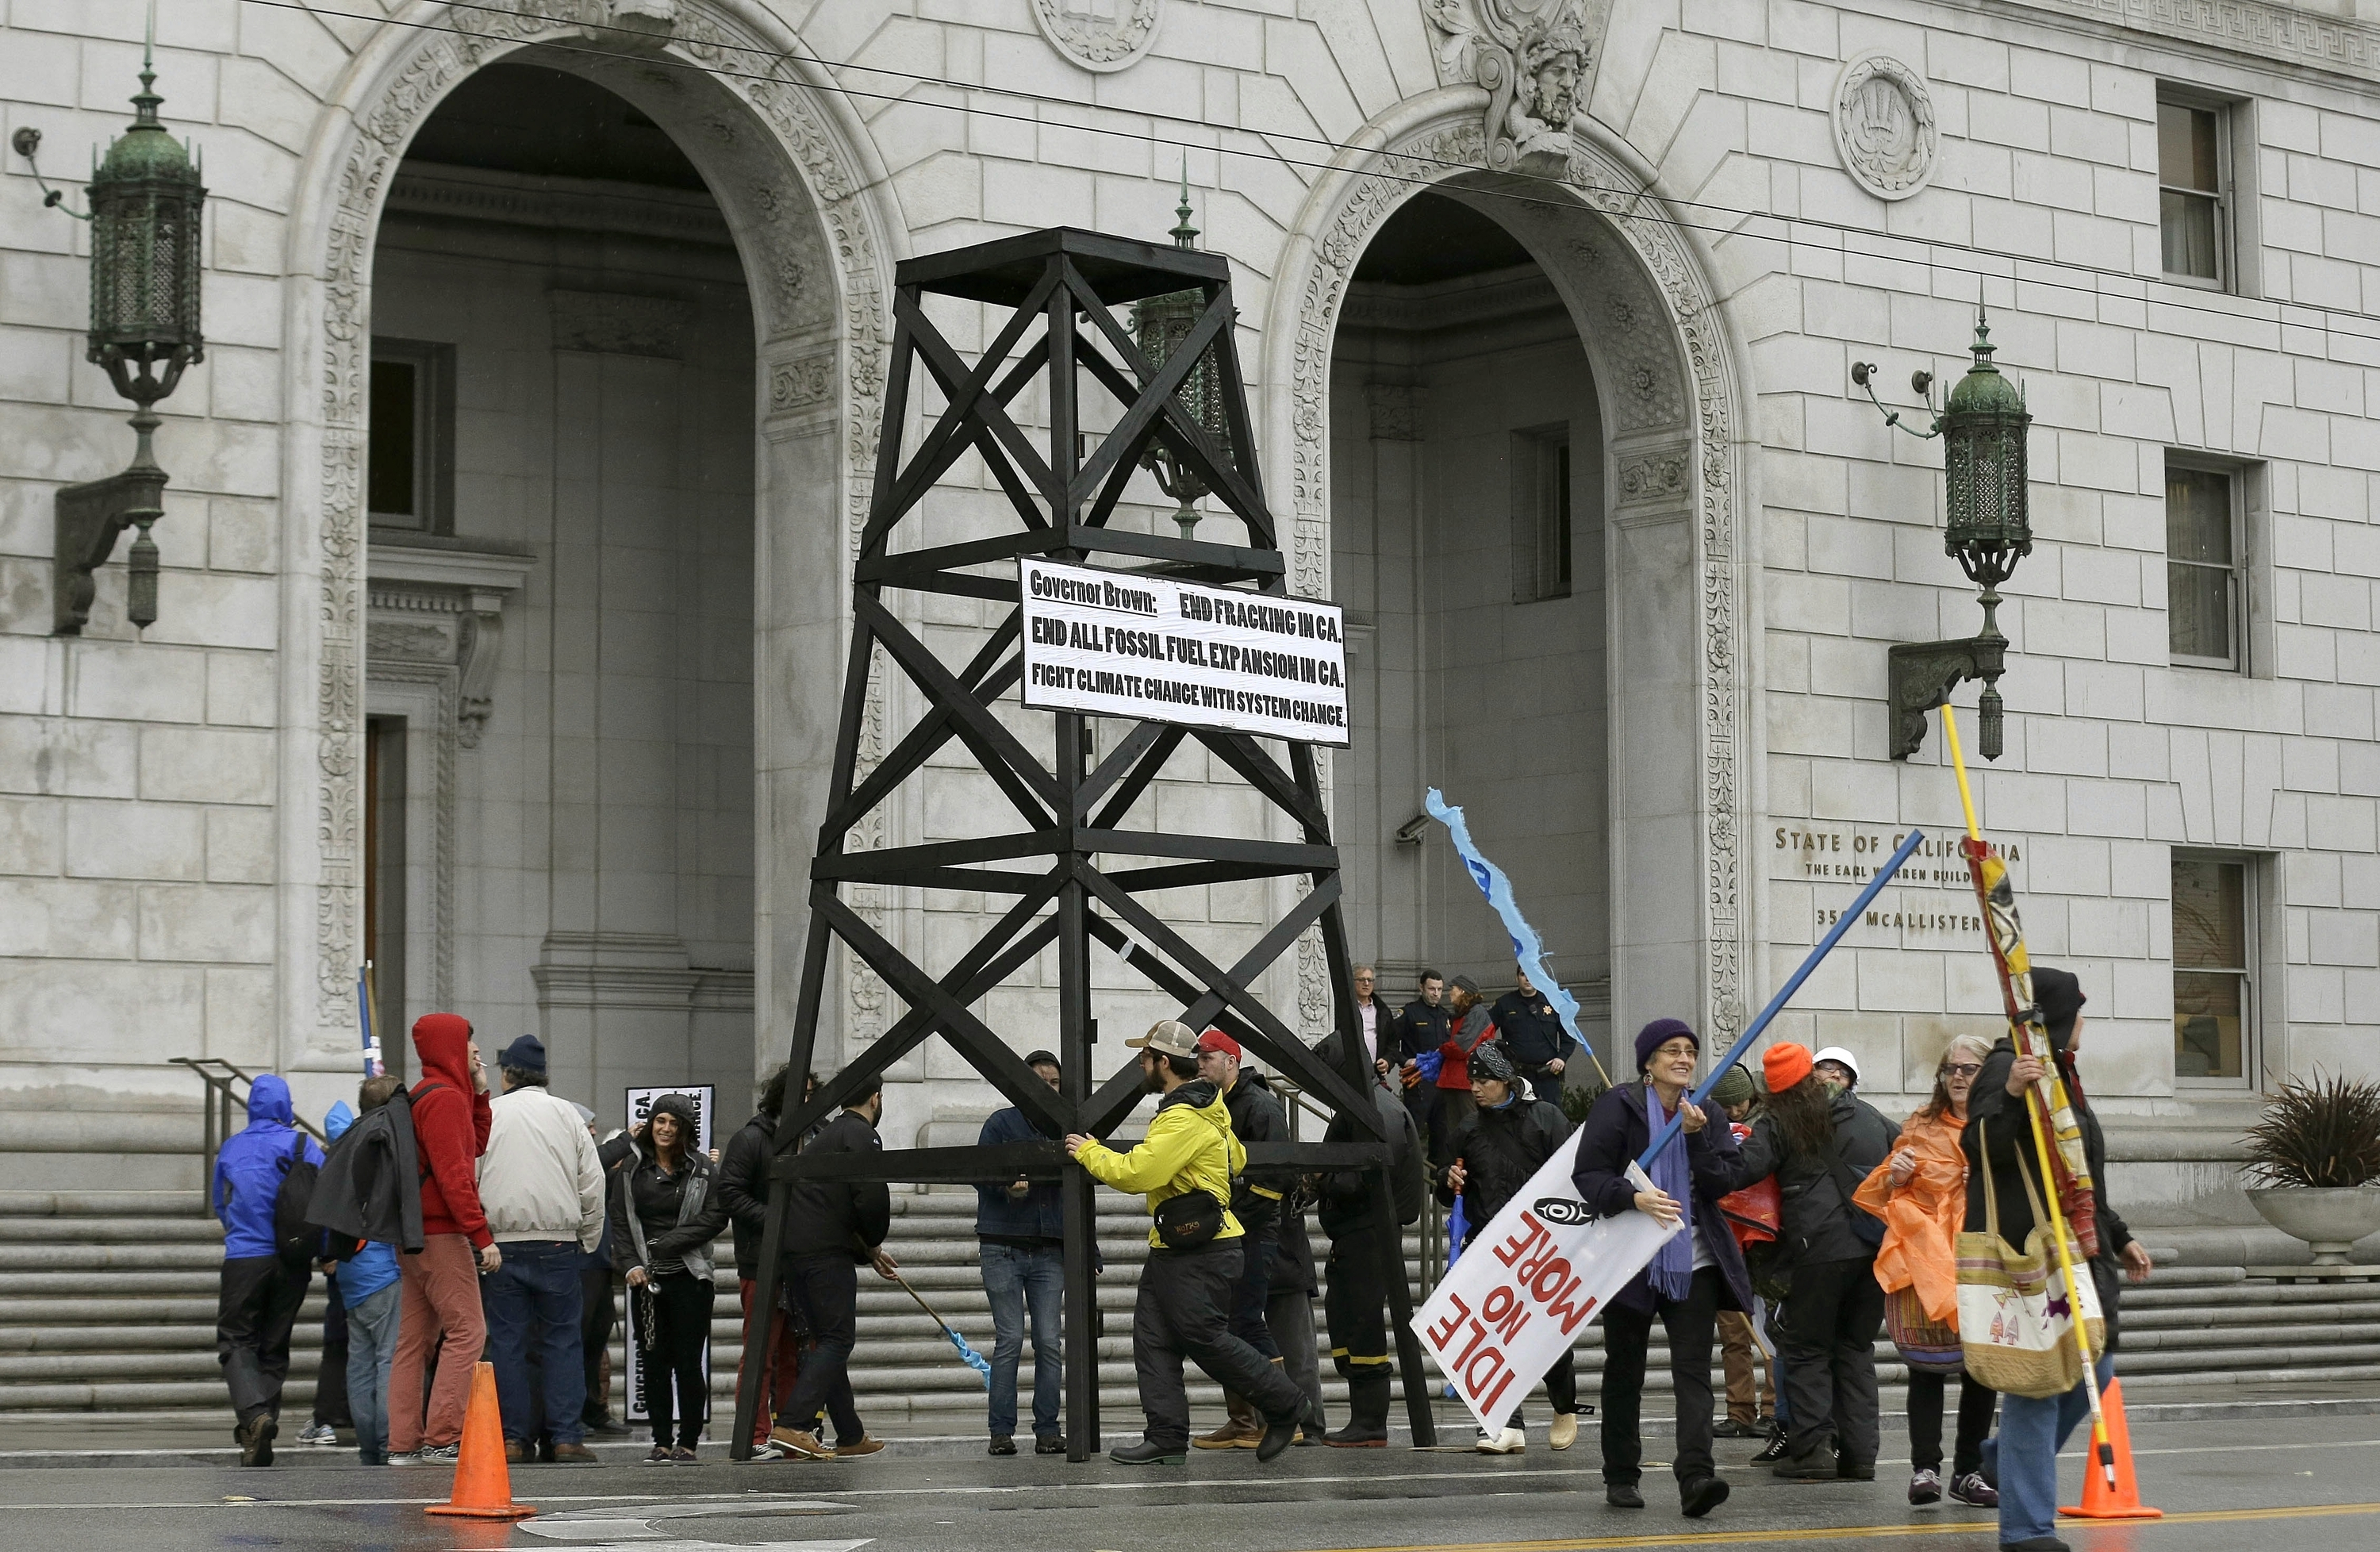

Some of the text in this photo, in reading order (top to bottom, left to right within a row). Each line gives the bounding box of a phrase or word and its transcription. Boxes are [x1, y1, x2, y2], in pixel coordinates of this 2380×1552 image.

[1031, 570, 1342, 643] Governor Brown: END FRACKING IN CA.
[1032, 616, 1345, 688] END ALL FOSSIL FUEL EXPANSION IN CA.
[1032, 663, 1347, 728] FIGHT CLIMATE CHANGE WITH SYSTEM CHANGE.
[1775, 827, 1841, 851] STATE
[1854, 835, 1879, 853] OF
[1806, 862, 1829, 875] THE
[1835, 865, 1868, 878] EARL
[1873, 866, 1927, 880] WRREN
[1866, 911, 1981, 931] MCALLISTER
[1492, 1210, 1598, 1336] MORE
[1482, 1285, 1532, 1346] NO
[1426, 1292, 1516, 1417] IDLE
